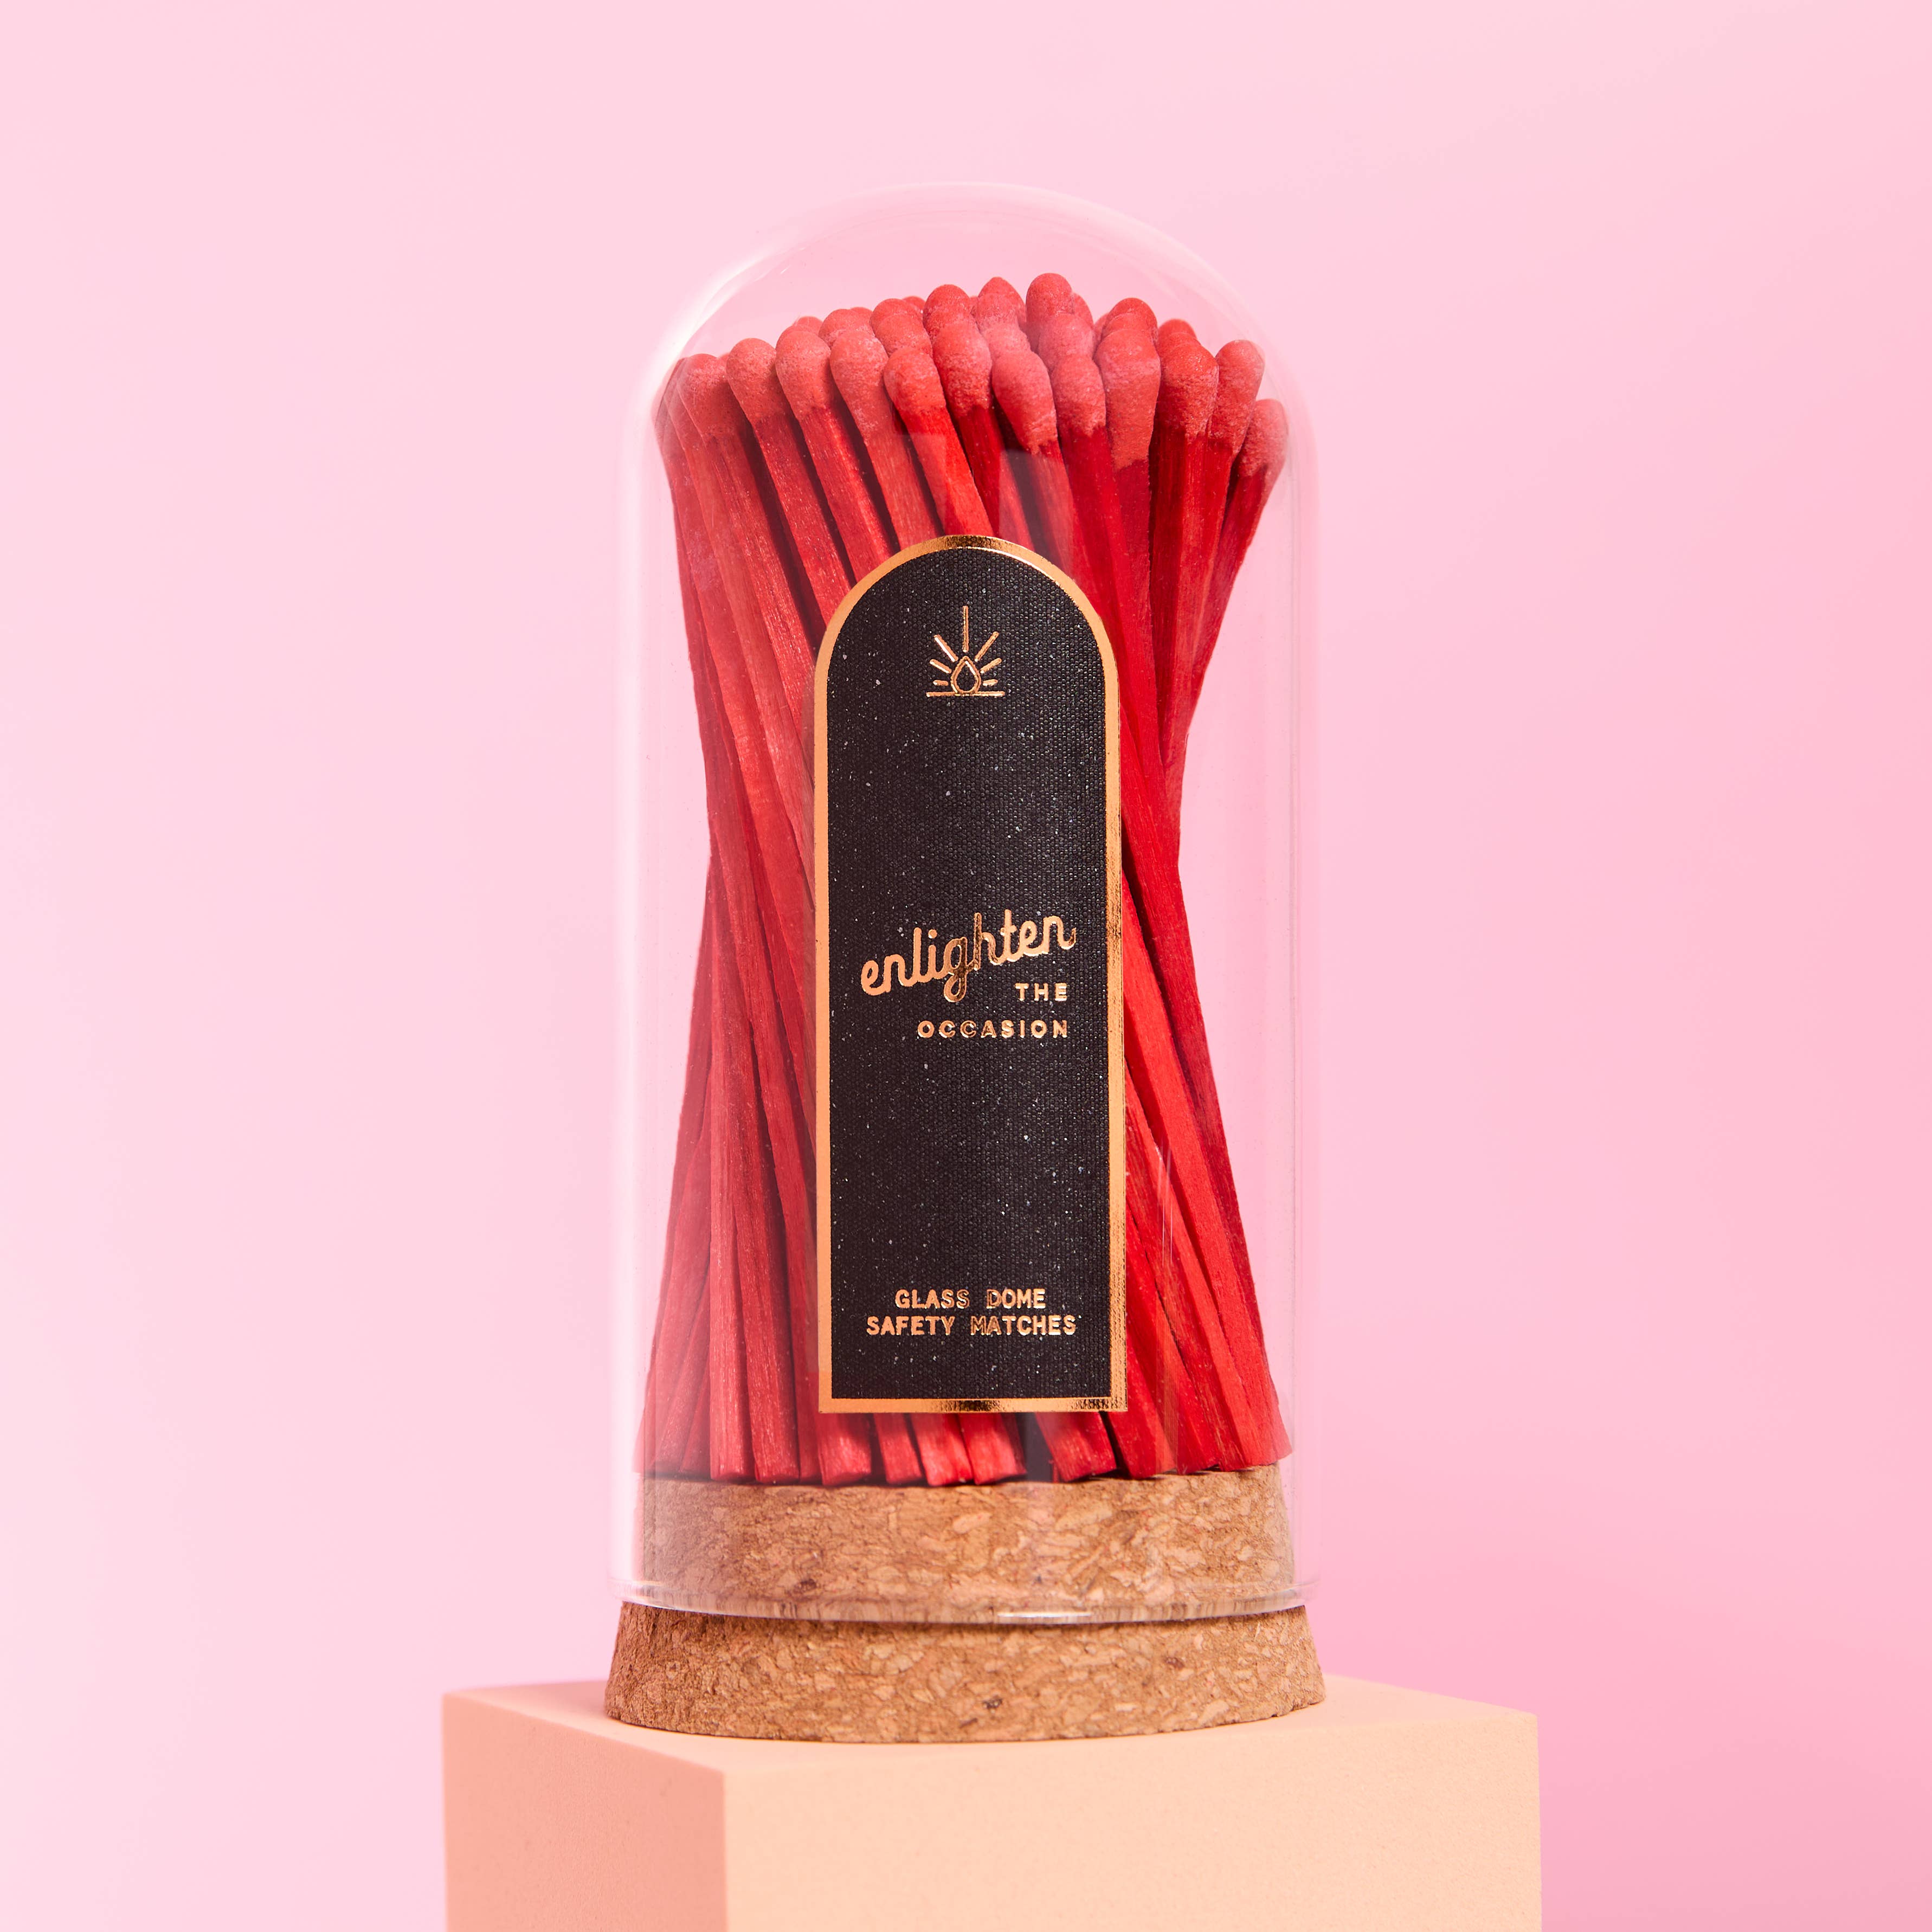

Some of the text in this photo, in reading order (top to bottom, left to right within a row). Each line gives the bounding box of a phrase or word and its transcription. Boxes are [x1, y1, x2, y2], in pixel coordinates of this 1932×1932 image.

[860, 909, 1077, 1003] enlighten
[1015, 982, 1068, 1001] THE
[916, 1019, 1068, 1039] OCCASION
[894, 1287, 1046, 1310] GLASS DOME
[866, 1315, 1077, 1336] SAFETY MATCHES
